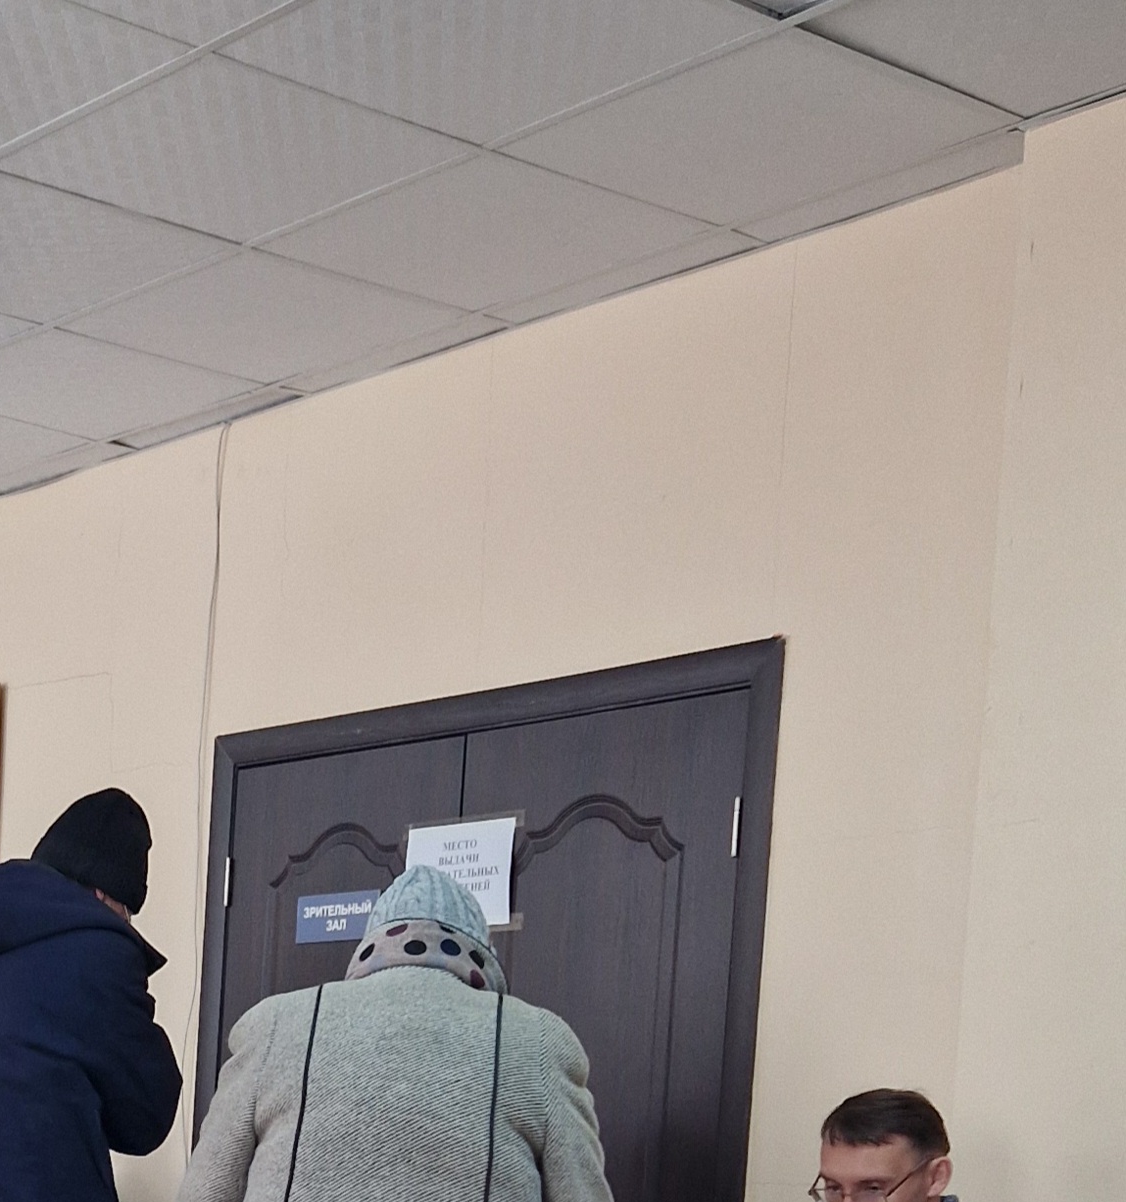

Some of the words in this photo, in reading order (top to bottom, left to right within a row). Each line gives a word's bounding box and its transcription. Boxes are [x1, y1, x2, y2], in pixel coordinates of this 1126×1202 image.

[443, 839, 477, 851] МЕСТО
[438, 853, 479, 866] ВЫДАЧИ
[447, 866, 499, 879] АТЕЛЬНЫХ
[303, 899, 372, 919] ЗРИТЕЛЬНЫЙ
[326, 919, 347, 932] ЗАЛ
